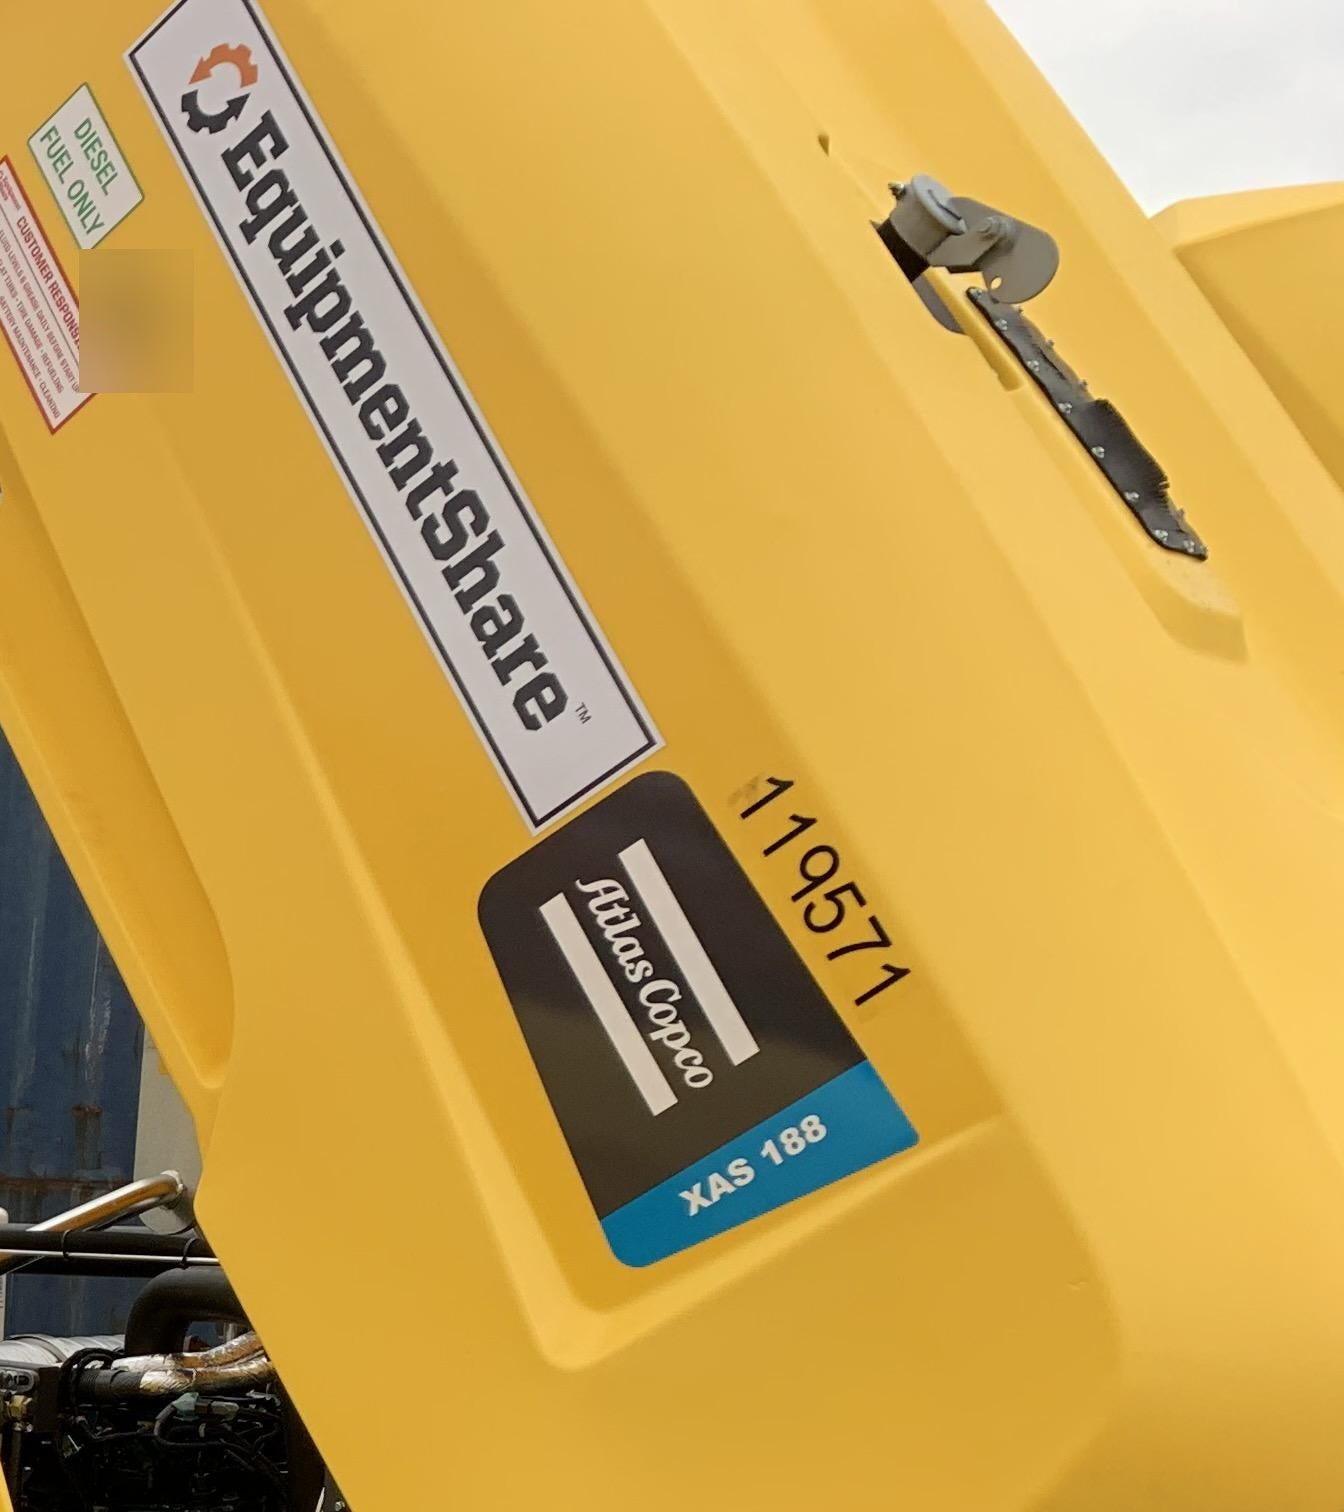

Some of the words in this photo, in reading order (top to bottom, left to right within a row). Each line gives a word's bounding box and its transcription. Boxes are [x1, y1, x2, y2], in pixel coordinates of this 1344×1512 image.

[38, 124, 73, 184] FUEL
[64, 179, 104, 235] ONLY
[72, 116, 118, 196] DIESEL
[7, 250, 23, 278] LEVELS
[21, 281, 39, 312] GREASE
[36, 309, 50, 332] DAILY
[45, 330, 63, 361] BEFORE
[59, 358, 74, 383] START
[16, 215, 52, 284] CUSTOMER
[47, 279, 79, 349] RESPONS
[11, 325, 42, 379] MAINTENANCE
[38, 380, 61, 419] CLEANING
[15, 300, 28, 319] TIRE
[23, 317, 43, 350] DAMAGE
[39, 351, 64, 394] REFUELING
[221, 110, 569, 732] EquipmentShare
[740, 776, 911, 1007] 119571
[575, 878, 654, 984] Atlas
[638, 978, 714, 1089] Copco
[679, 1157, 756, 1217] XAS
[759, 1114, 828, 1166] 188
